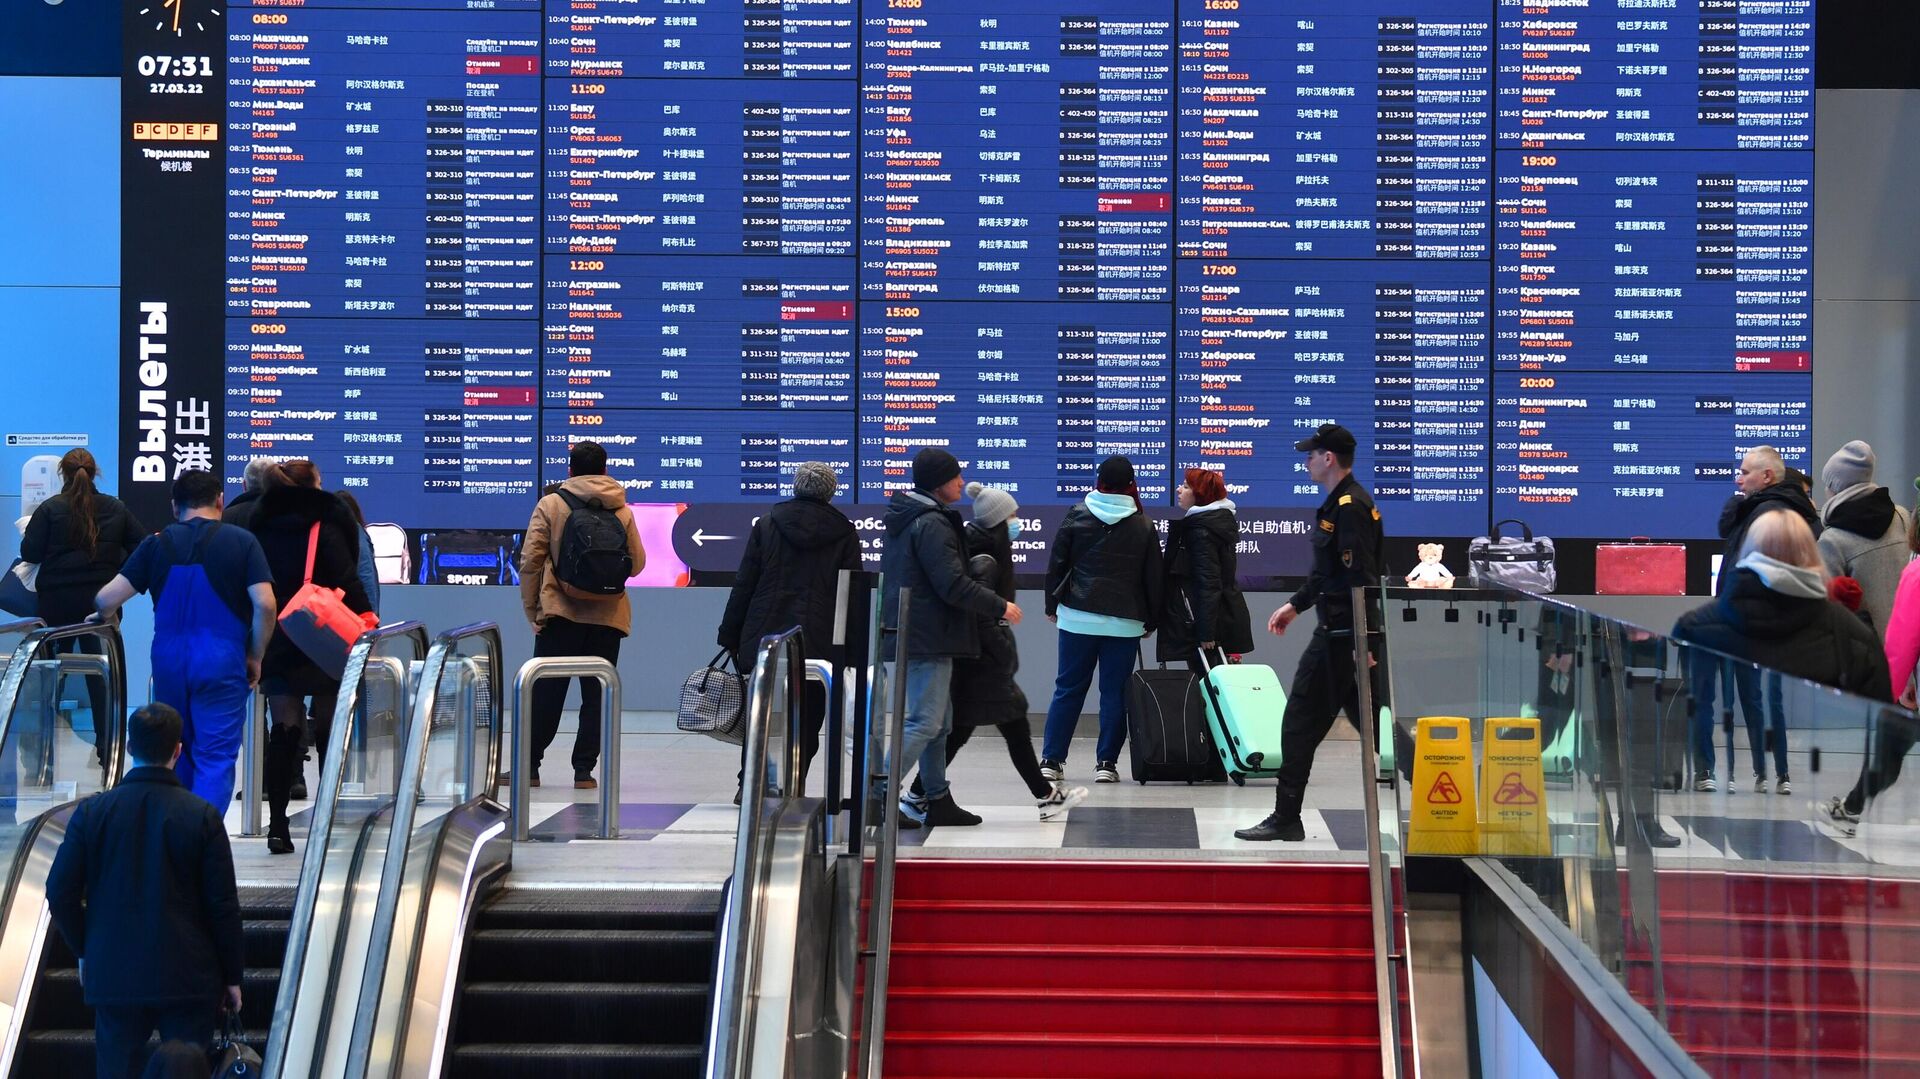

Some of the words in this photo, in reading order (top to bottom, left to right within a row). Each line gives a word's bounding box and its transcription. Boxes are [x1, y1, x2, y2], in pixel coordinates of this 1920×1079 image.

[888, 0, 922, 9] 14:00
[1204, 0, 1239, 10] 16:00
[252, 14, 288, 25] 08:00
[548, 15, 570, 23] 10:40
[570, 14, 657, 26] Санкт-Петербург
[865, 18, 886, 26] 14:00
[886, 17, 928, 27] Тюмень
[1181, 20, 1203, 28] 16:10
[1203, 19, 1240, 29] Казань
[229, 34, 251, 42] 08:00
[252, 33, 309, 43] Махачкала
[865, 40, 886, 48] 14:00
[886, 39, 942, 49] Челябинск
[137, 55, 213, 76] 07:31
[229, 56, 251, 64] 08:10
[252, 55, 311, 66] Геленджик
[465, 60, 501, 68] Отменен
[570, 59, 623, 71] Мурманск
[1181, 64, 1202, 72] 16:15
[1202, 63, 1229, 73] Сочи
[1500, 65, 1521, 73] 18:30
[1521, 64, 1582, 76] Н.Новгород
[149, 83, 204, 94] 27.03.22
[571, 84, 605, 94] 11:00
[1499, 87, 1521, 95] 18:35
[1521, 87, 1556, 96] Минск
[570, 103, 595, 115] Баку
[135, 124, 145, 135] B
[152, 124, 161, 135] C
[169, 125, 179, 135] D
[185, 125, 195, 135] E
[202, 125, 211, 136] F
[252, 122, 297, 134] Грозный
[548, 126, 569, 134] 11:15
[569, 125, 596, 136] Орск
[864, 128, 885, 136] 14:25
[885, 127, 907, 139] Уфа
[142, 148, 211, 160] Терминалы
[160, 160, 193, 172] 候机楼
[1522, 156, 1557, 166] 19:00
[251, 166, 278, 176] Сочи
[885, 172, 952, 182] Нижнекамск
[1202, 174, 1244, 186] Саратов
[1097, 197, 1133, 205] Отменен
[228, 211, 250, 219] 08:40
[251, 210, 286, 220] Минск
[433, 215, 463, 223] 402-430
[1520, 219, 1576, 229] Челябинск
[547, 236, 568, 244] 11:55
[568, 235, 617, 247] Абу-Даби
[750, 240, 779, 248] 367-375
[570, 260, 604, 271] 12:00
[1202, 265, 1237, 276] 17:00
[1520, 264, 1556, 276] Якутск
[863, 283, 884, 291] 14:55
[885, 282, 939, 294] Волгоград
[251, 299, 312, 311] Ставрополь
[568, 302, 613, 312] Нальчик
[886, 307, 920, 318] 15:00
[1179, 307, 1200, 315] 17:05
[1201, 306, 1290, 317] Южно-Сахалинск
[251, 323, 287, 334] 09:00
[863, 327, 885, 335] 15:00
[885, 326, 924, 338] Самара
[1497, 331, 1518, 339] 19:55
[1519, 331, 1565, 341] Магадан
[1179, 351, 1201, 360] 17:15
[1201, 350, 1256, 362] Хабаровск
[1735, 356, 1771, 364] Отменен
[227, 366, 249, 374] 09:05
[250, 365, 319, 377] Новосибирск
[1179, 373, 1201, 381] 17:30
[1201, 373, 1243, 385] Иркутск
[1519, 377, 1555, 388] 20:00
[132, 301, 168, 482] Вылеты
[227, 388, 249, 396] 09:30
[250, 387, 283, 397] Пенза
[463, 391, 499, 399] Отменен
[568, 390, 605, 400] Казань
[862, 393, 884, 402] 15:05
[884, 392, 956, 404] Магнитогорск
[569, 414, 603, 425] 13:00
[1496, 420, 1518, 429] 20:15
[1518, 419, 1546, 430] Дели
[1178, 440, 1200, 448] 17:50
[1200, 439, 1253, 451] Мурманск
[1496, 464, 1518, 473] 20:25
[1518, 463, 1580, 475] Красноярск
[1236, 520, 1312, 535] 以自助值机，
[1010, 540, 1046, 550] аться
[447, 574, 488, 585] SPORT
